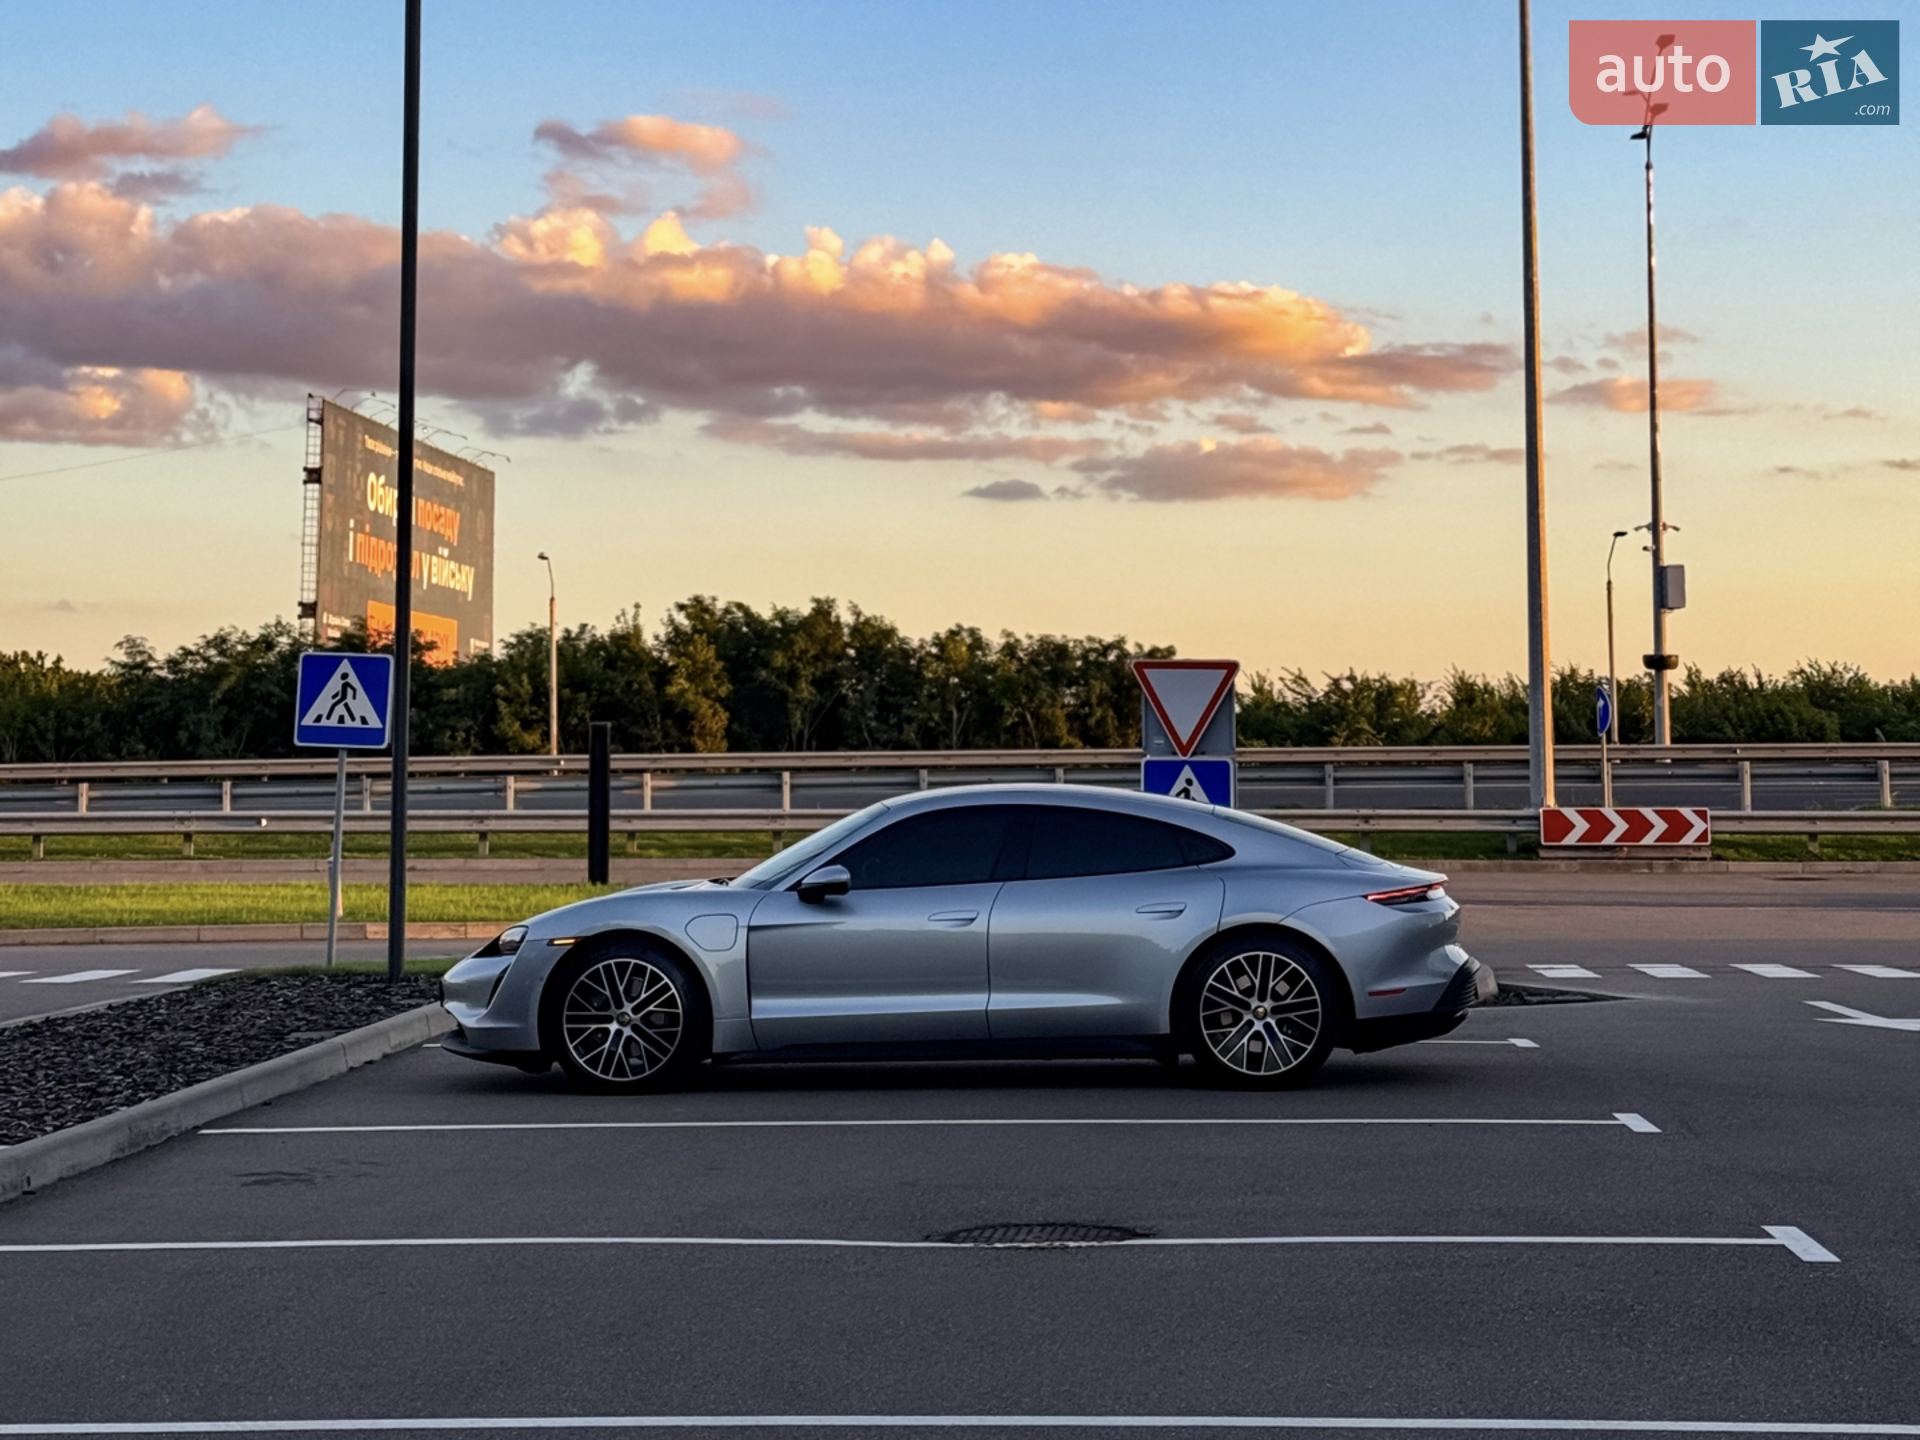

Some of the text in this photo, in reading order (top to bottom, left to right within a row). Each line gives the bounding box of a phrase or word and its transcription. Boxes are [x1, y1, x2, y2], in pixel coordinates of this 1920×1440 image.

[415, 497, 461, 547] посаду
[348, 517, 355, 562] і
[421, 551, 431, 590] у
[430, 546, 475, 602] війську
